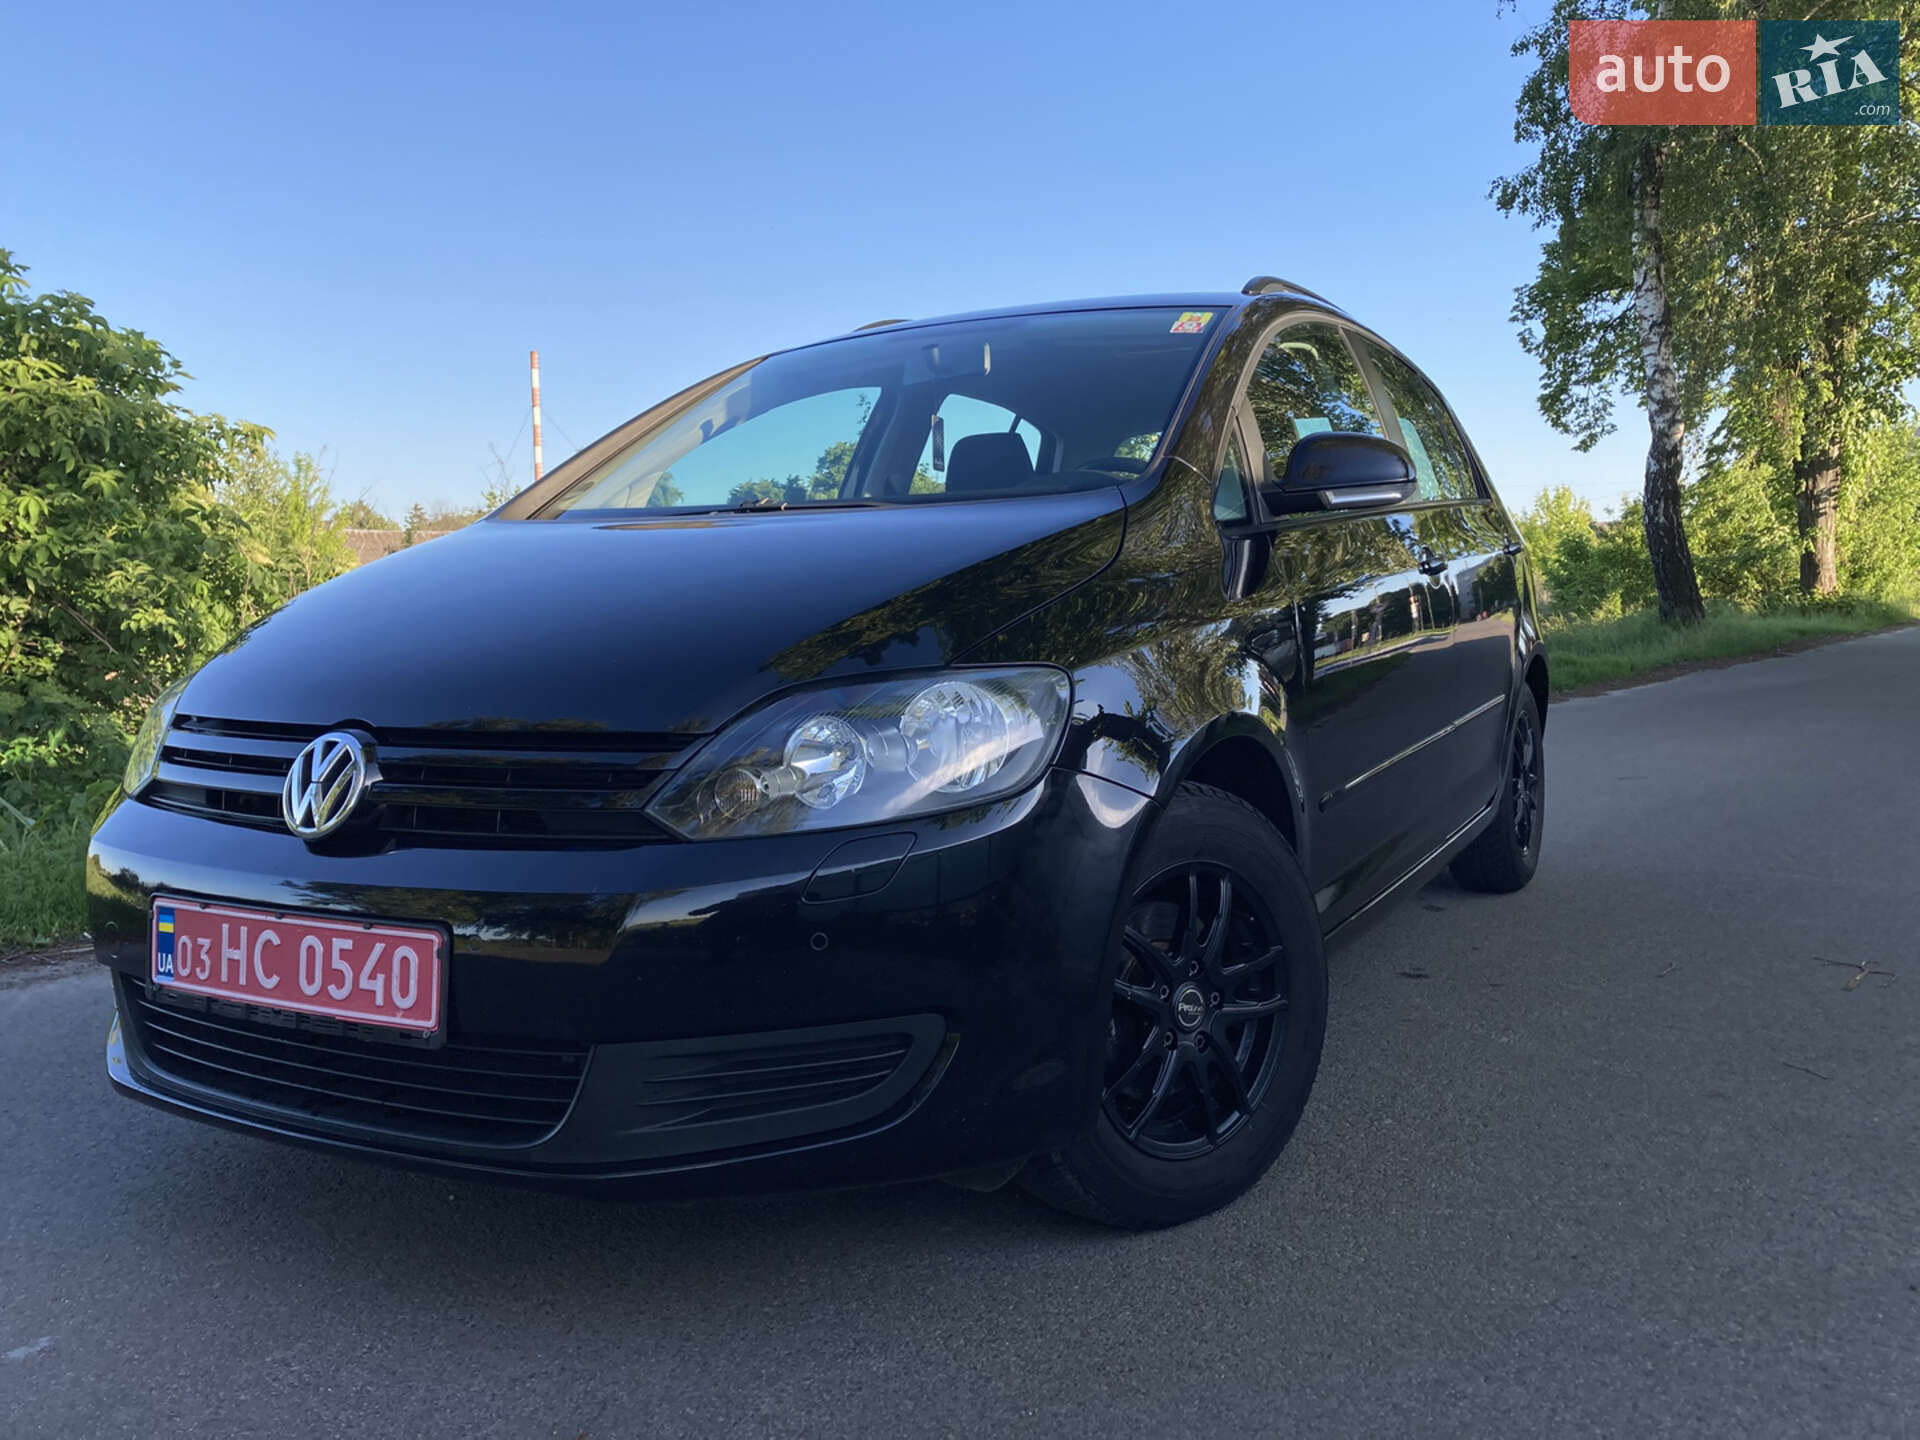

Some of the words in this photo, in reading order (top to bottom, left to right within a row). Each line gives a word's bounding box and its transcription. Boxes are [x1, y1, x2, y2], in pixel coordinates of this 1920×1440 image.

[157, 952, 174, 974] UA
[177, 935, 211, 980] 03
[220, 923, 281, 990] HC
[299, 935, 418, 1009] 0540
